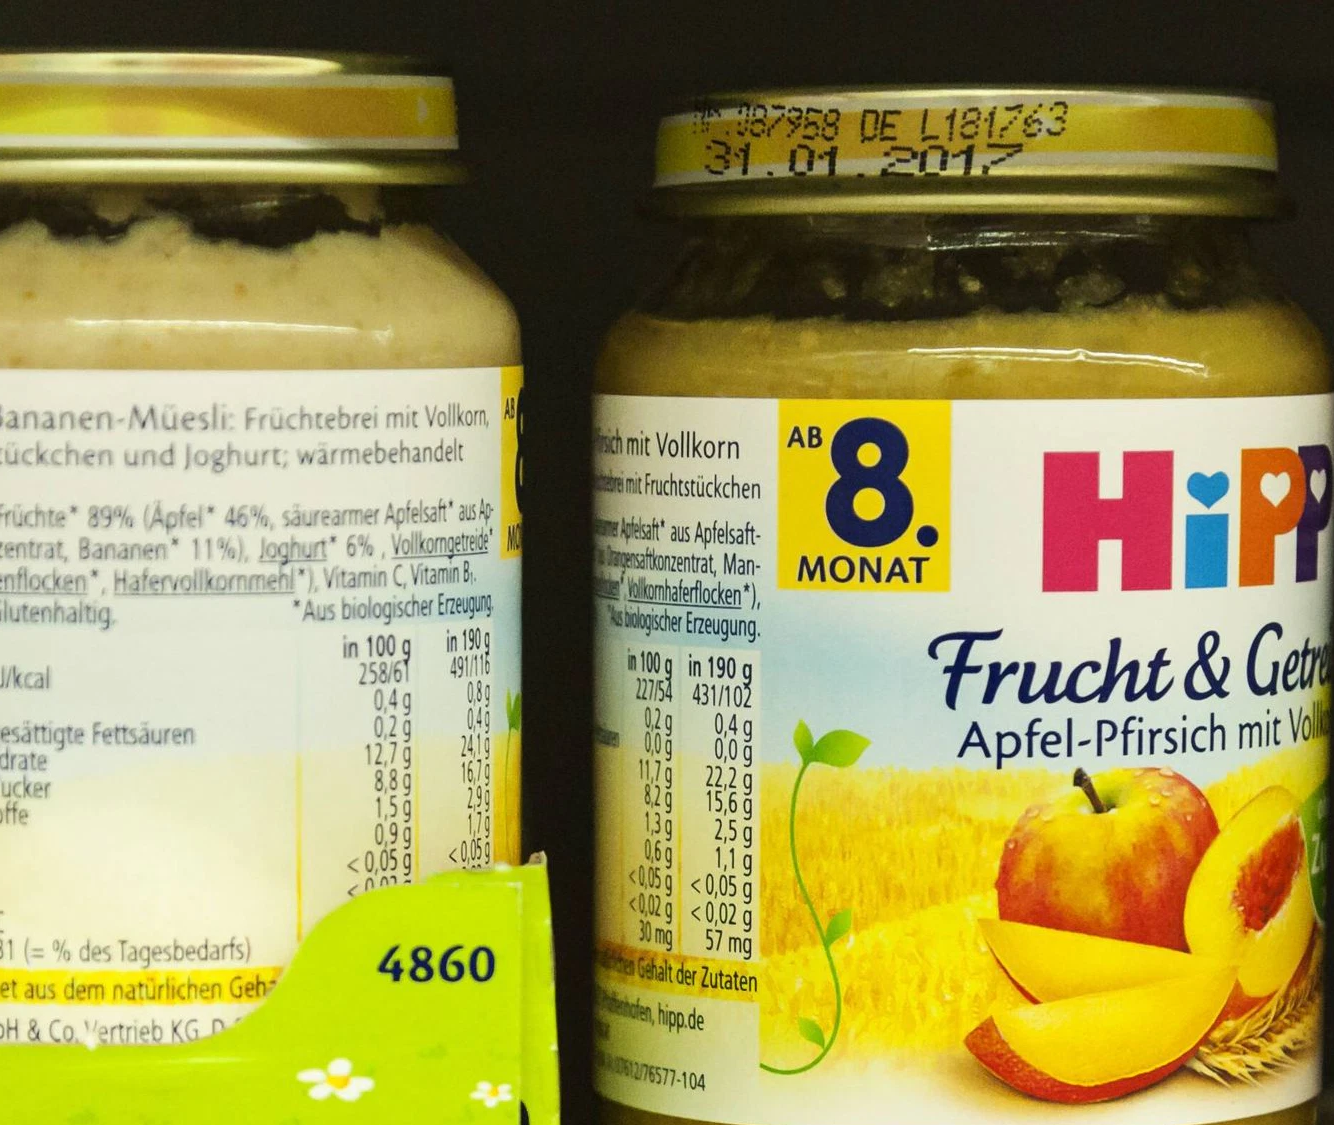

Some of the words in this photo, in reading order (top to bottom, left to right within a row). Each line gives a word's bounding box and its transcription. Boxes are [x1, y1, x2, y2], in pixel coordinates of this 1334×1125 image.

[861, 108, 897, 143] DE
[704, 139, 1024, 178] 31.01.2017
[245, 403, 379, 432] Früchtebrei
[386, 405, 419, 429] mit
[425, 403, 490, 430] Vollkorn,
[655, 430, 740, 460] Vollkorn
[787, 425, 824, 449] AB
[124, 443, 175, 467] und
[185, 442, 289, 474] Joghurt;
[297, 437, 465, 466] wärmebehandelt
[644, 473, 761, 500] Fruchtstückchen
[825, 416, 940, 549] 8.
[1042, 443, 1333, 593] HiPP
[797, 554, 931, 585] MONAT
[342, 595, 433, 626] biologischer
[438, 592, 493, 617] Erzeugung.
[686, 611, 761, 644] Erzeugung.
[358, 660, 410, 685] 258/61
[450, 653, 491, 678] 491/116
[928, 627, 1175, 712] Frucht
[1183, 628, 1231, 701] &
[692, 682, 752, 709] 431/102
[91, 720, 196, 745] Fettsäuren
[957, 711, 1227, 769] Apfel-Pfirsich
[1238, 708, 1281, 750] mit
[376, 945, 497, 986] 4860
[700, 964, 758, 992] Zutaten
[657, 1008, 705, 1034] hipp.de
